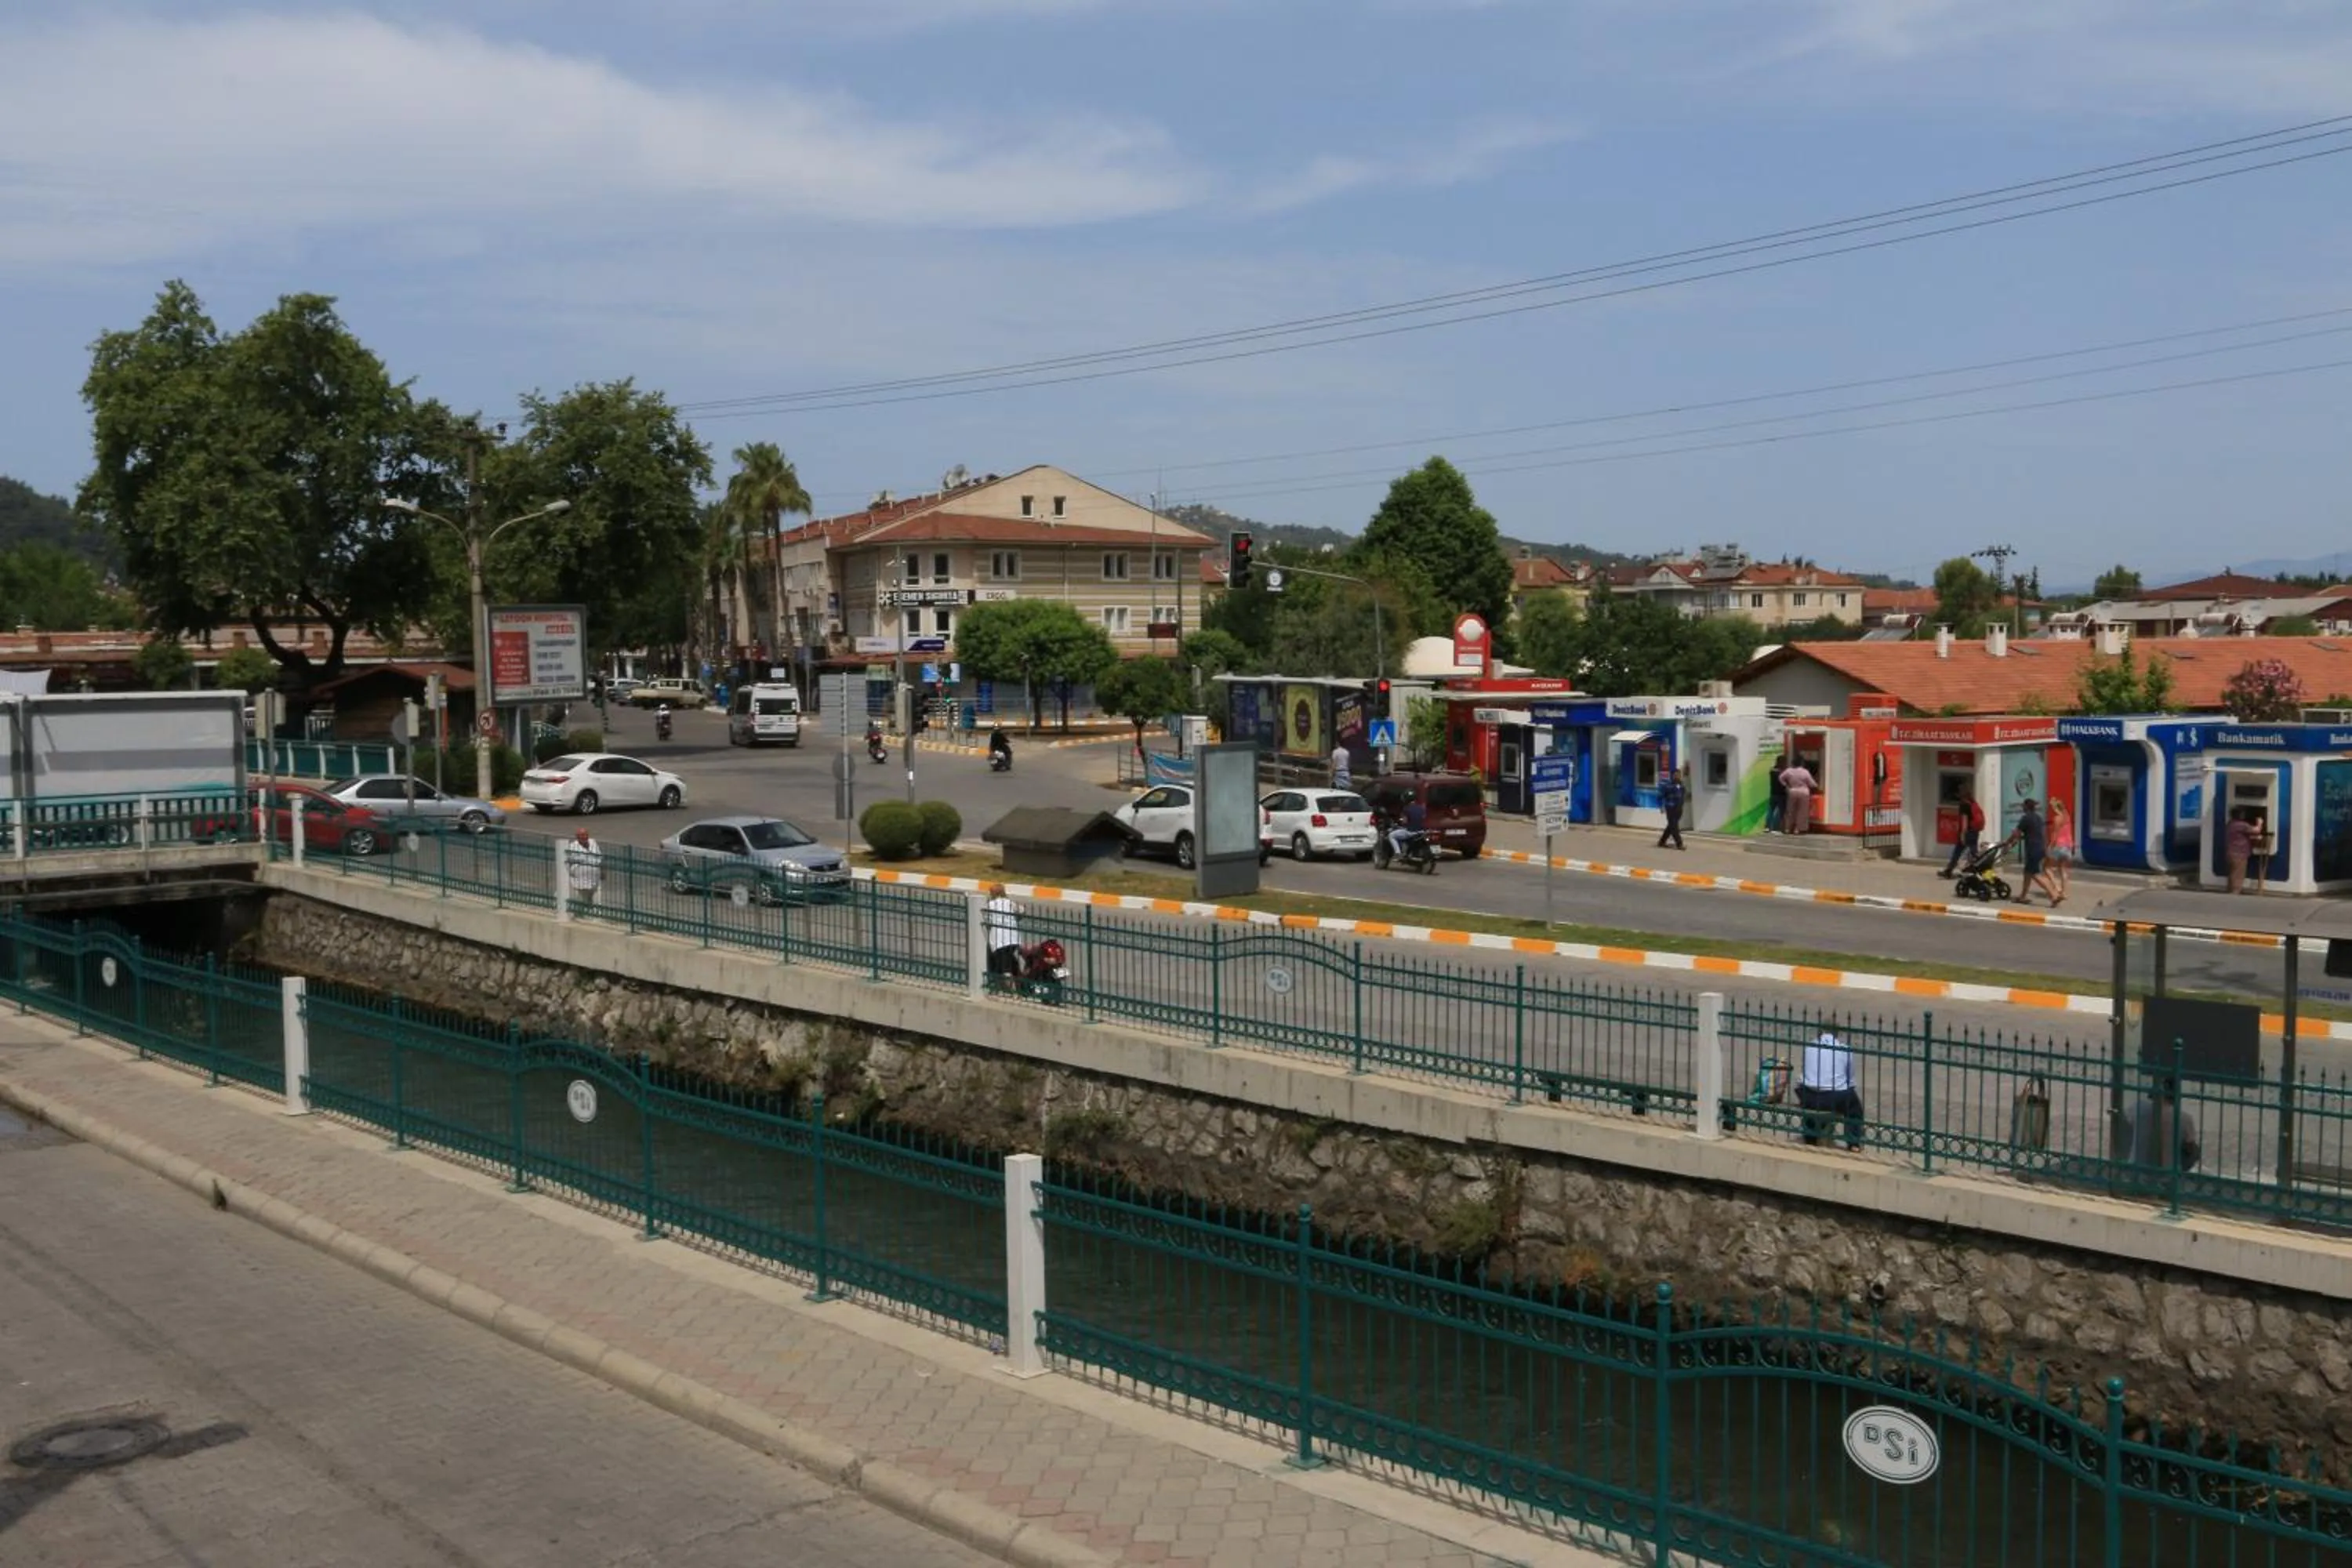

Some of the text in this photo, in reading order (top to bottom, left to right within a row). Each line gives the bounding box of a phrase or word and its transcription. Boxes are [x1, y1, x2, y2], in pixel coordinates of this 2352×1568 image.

[1613, 704, 1646, 715] DenizBank
[1675, 704, 1716, 716] DenizBank
[2071, 725, 2118, 735] HALKBANK
[2217, 731, 2286, 745] Bankamatik
